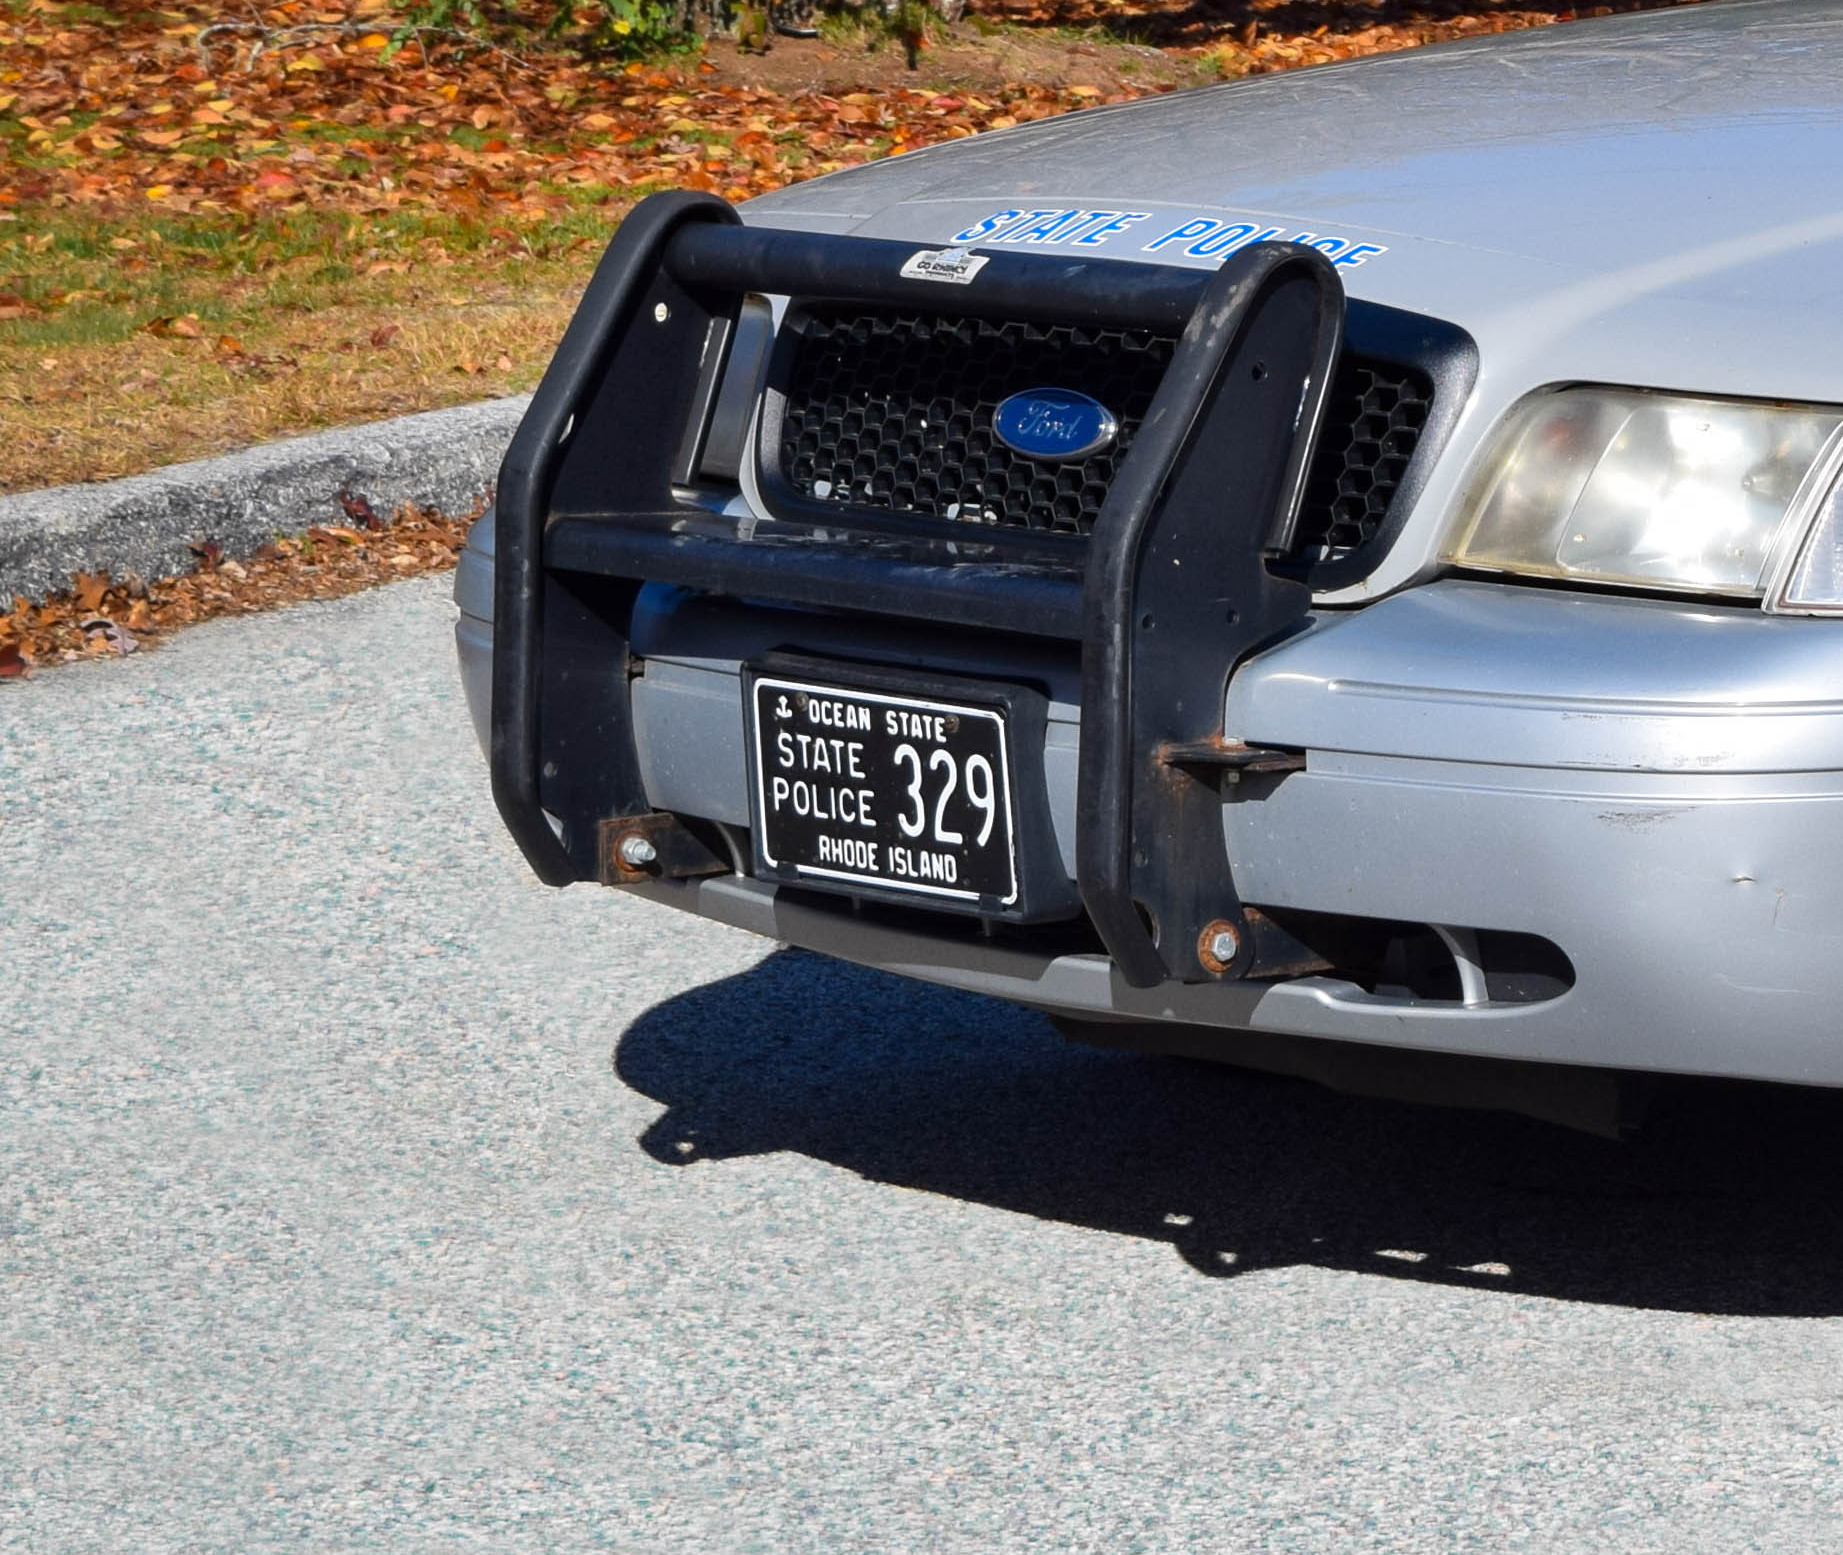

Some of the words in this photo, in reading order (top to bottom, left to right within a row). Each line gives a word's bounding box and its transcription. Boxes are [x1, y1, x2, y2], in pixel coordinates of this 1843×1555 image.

[951, 209, 1153, 247] STATE
[1018, 399, 1084, 440] Ford
[808, 699, 871, 732] OCEAN
[886, 709, 947, 743] STATE
[776, 731, 866, 780] STATE
[772, 776, 877, 827] POLICE
[893, 743, 996, 848] 329
[818, 835, 880, 872] RHODE
[888, 846, 958, 884] ISLAND
